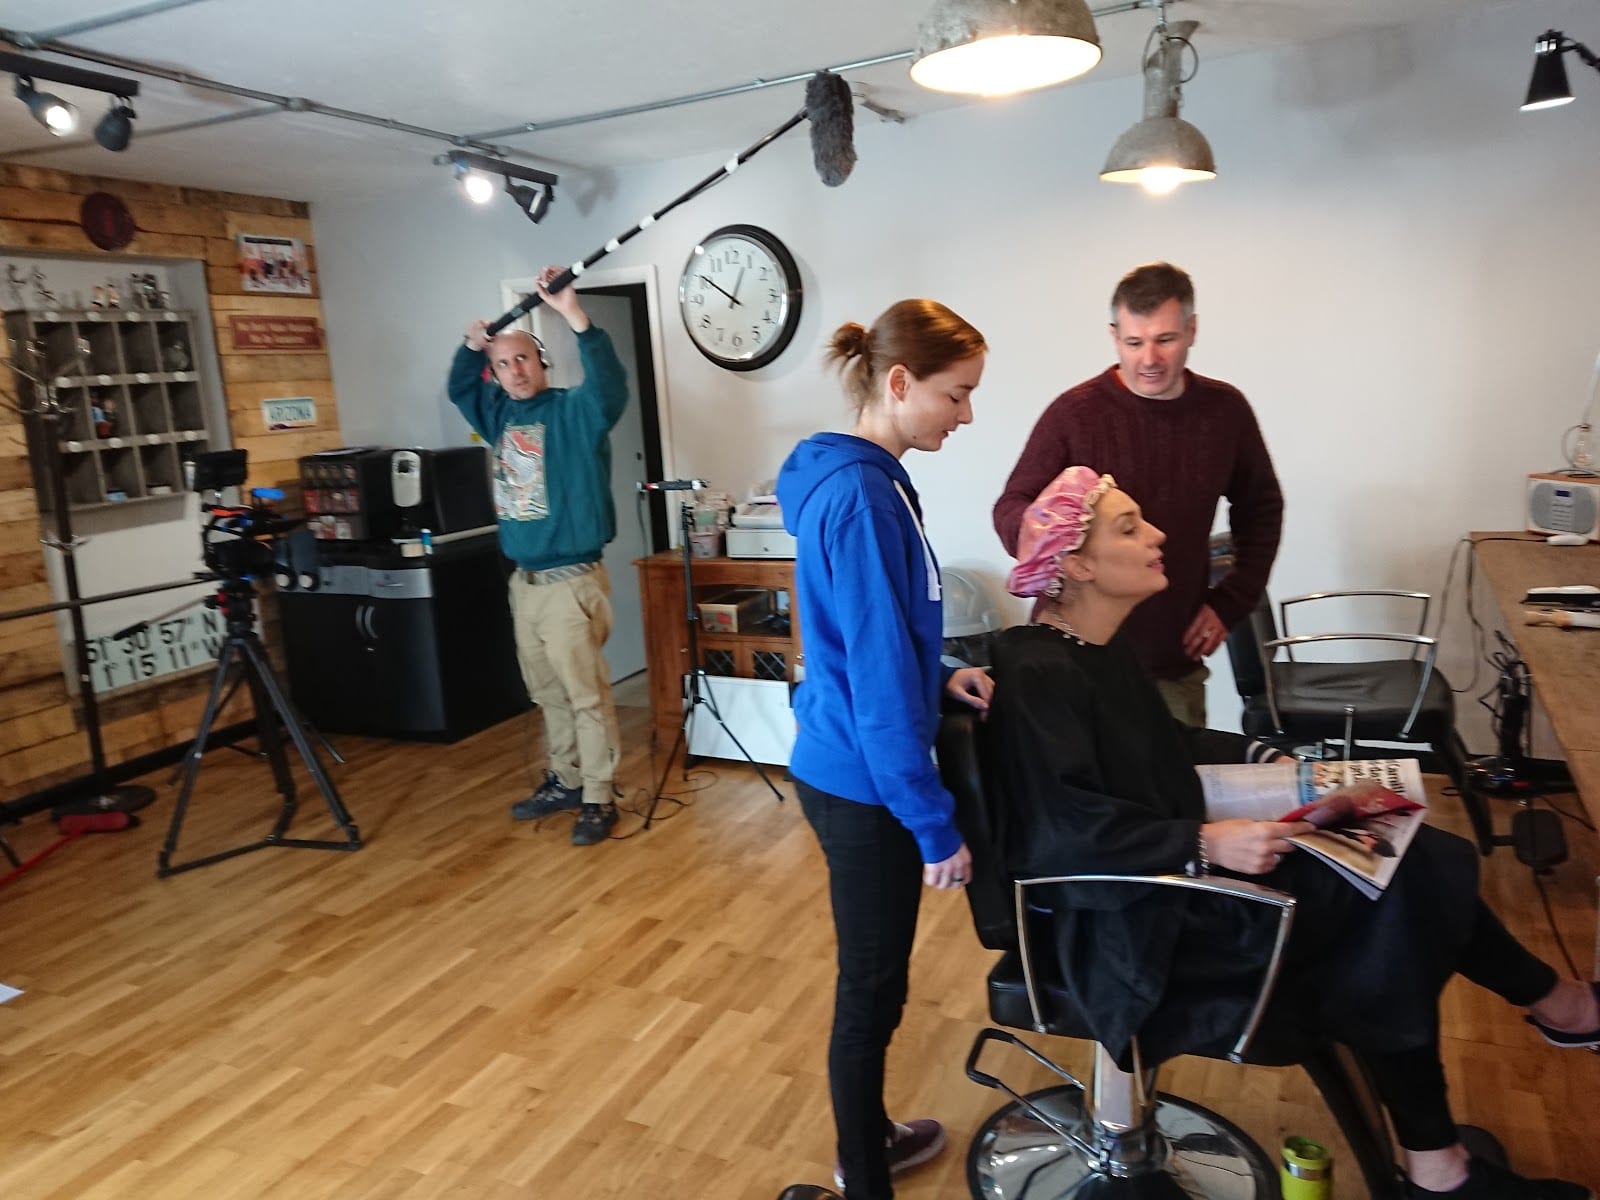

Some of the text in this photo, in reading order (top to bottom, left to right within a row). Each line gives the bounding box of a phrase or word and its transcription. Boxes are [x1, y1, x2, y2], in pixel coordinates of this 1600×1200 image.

[725, 250, 740, 264] 12
[746, 255, 752, 269] 1
[710, 258, 722, 272] 11
[759, 266, 769, 281] 2
[768, 288, 777, 303] 3
[701, 314, 711, 329] 8
[762, 310, 773, 324] 4
[716, 327, 724, 342] 7
[731, 333, 743, 347] 6
[751, 325, 760, 343] 5
[202, 610, 217, 635] N
